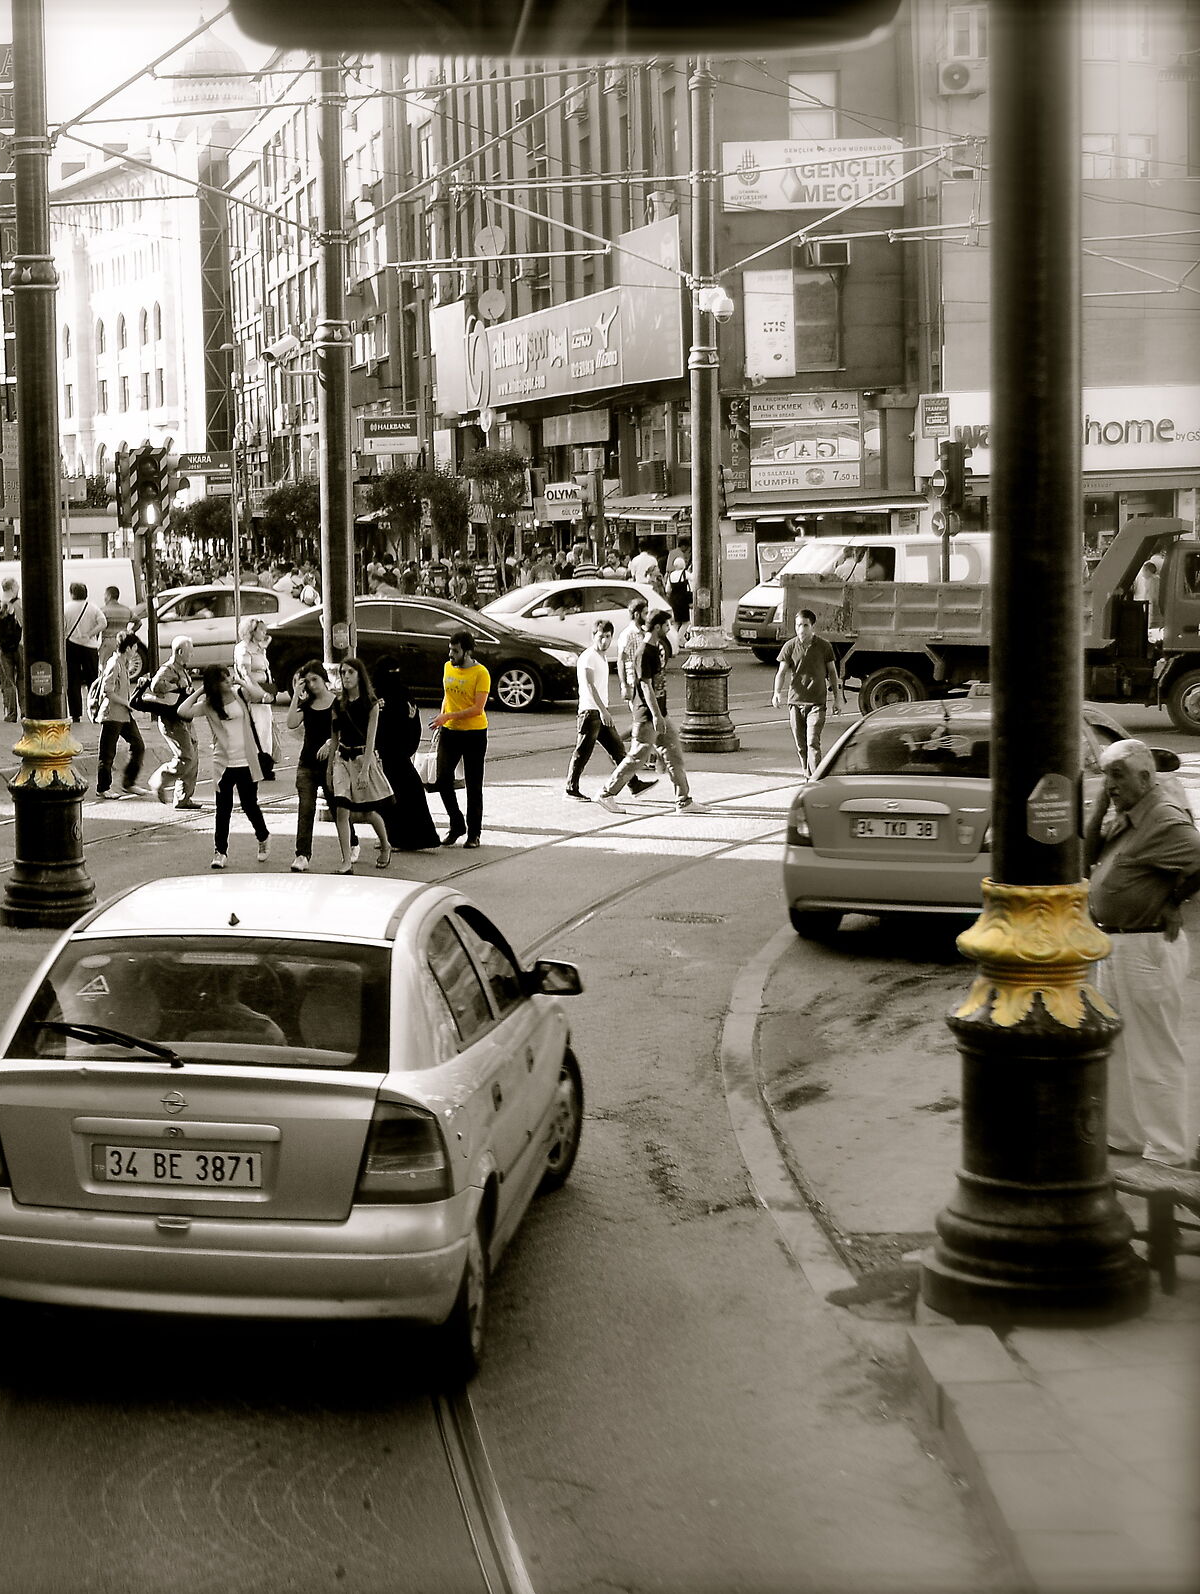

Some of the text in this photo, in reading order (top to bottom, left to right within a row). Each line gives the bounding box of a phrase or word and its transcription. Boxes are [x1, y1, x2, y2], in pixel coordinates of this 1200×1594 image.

[831, 400, 848, 410] 4.50
[1085, 415, 1174, 445] home
[1176, 432, 1186, 442] by
[754, 477, 799, 487] KUMPİR
[833, 471, 851, 481] 7.50
[858, 821, 873, 834] 34
[917, 823, 932, 836] 38
[110, 1150, 138, 1177] 34
[154, 1152, 182, 1179] BE
[196, 1155, 254, 1182] 3871
